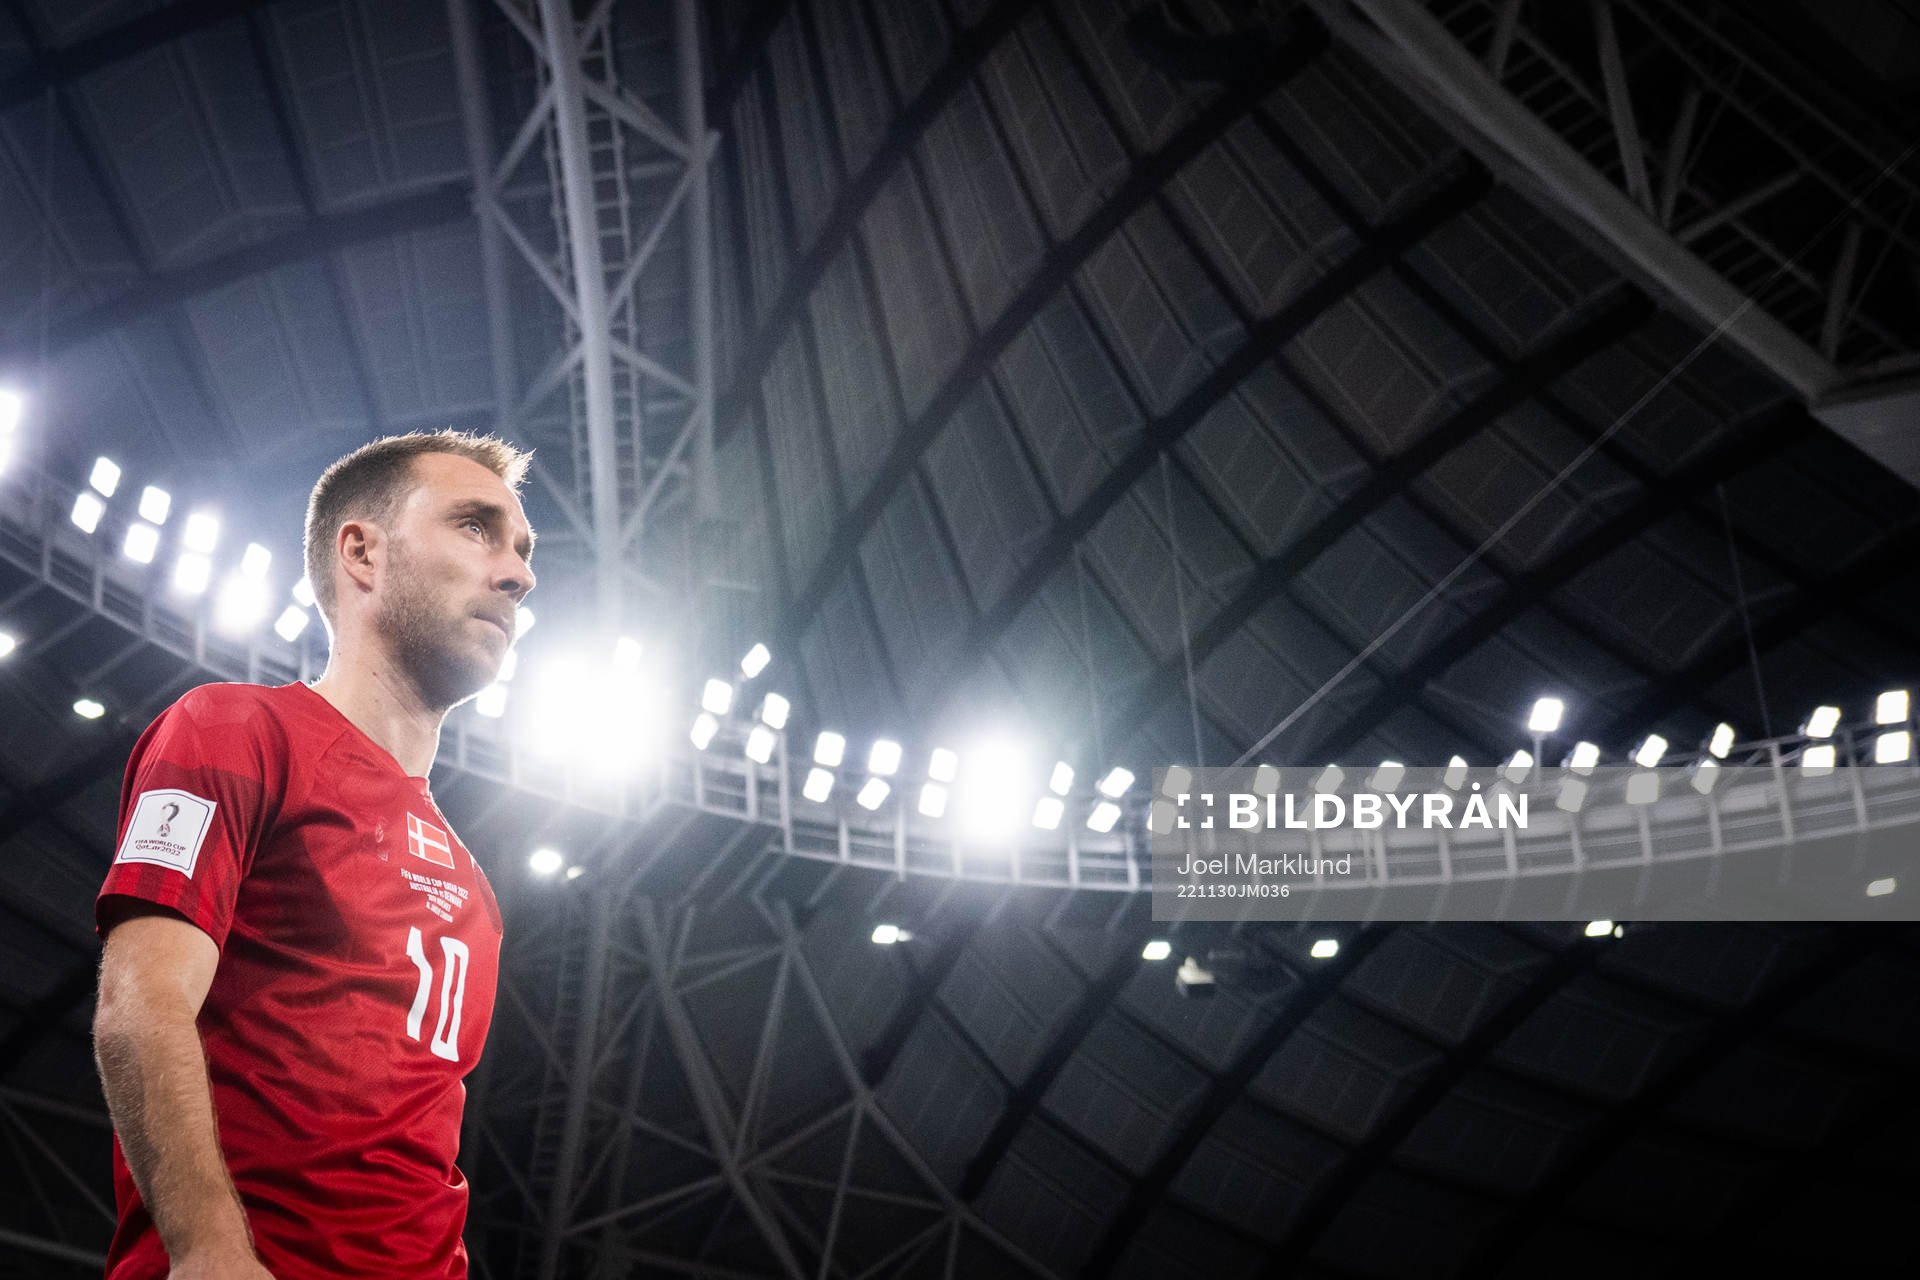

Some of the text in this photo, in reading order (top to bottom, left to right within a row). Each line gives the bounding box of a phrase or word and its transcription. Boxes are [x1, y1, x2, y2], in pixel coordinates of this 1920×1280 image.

[149, 839, 172, 847] WORLD
[173, 843, 186, 851] CUP
[400, 867, 412, 880] FIFA
[411, 873, 431, 885] WORLD
[430, 878, 443, 888] CUP
[406, 926, 470, 1063] 10
